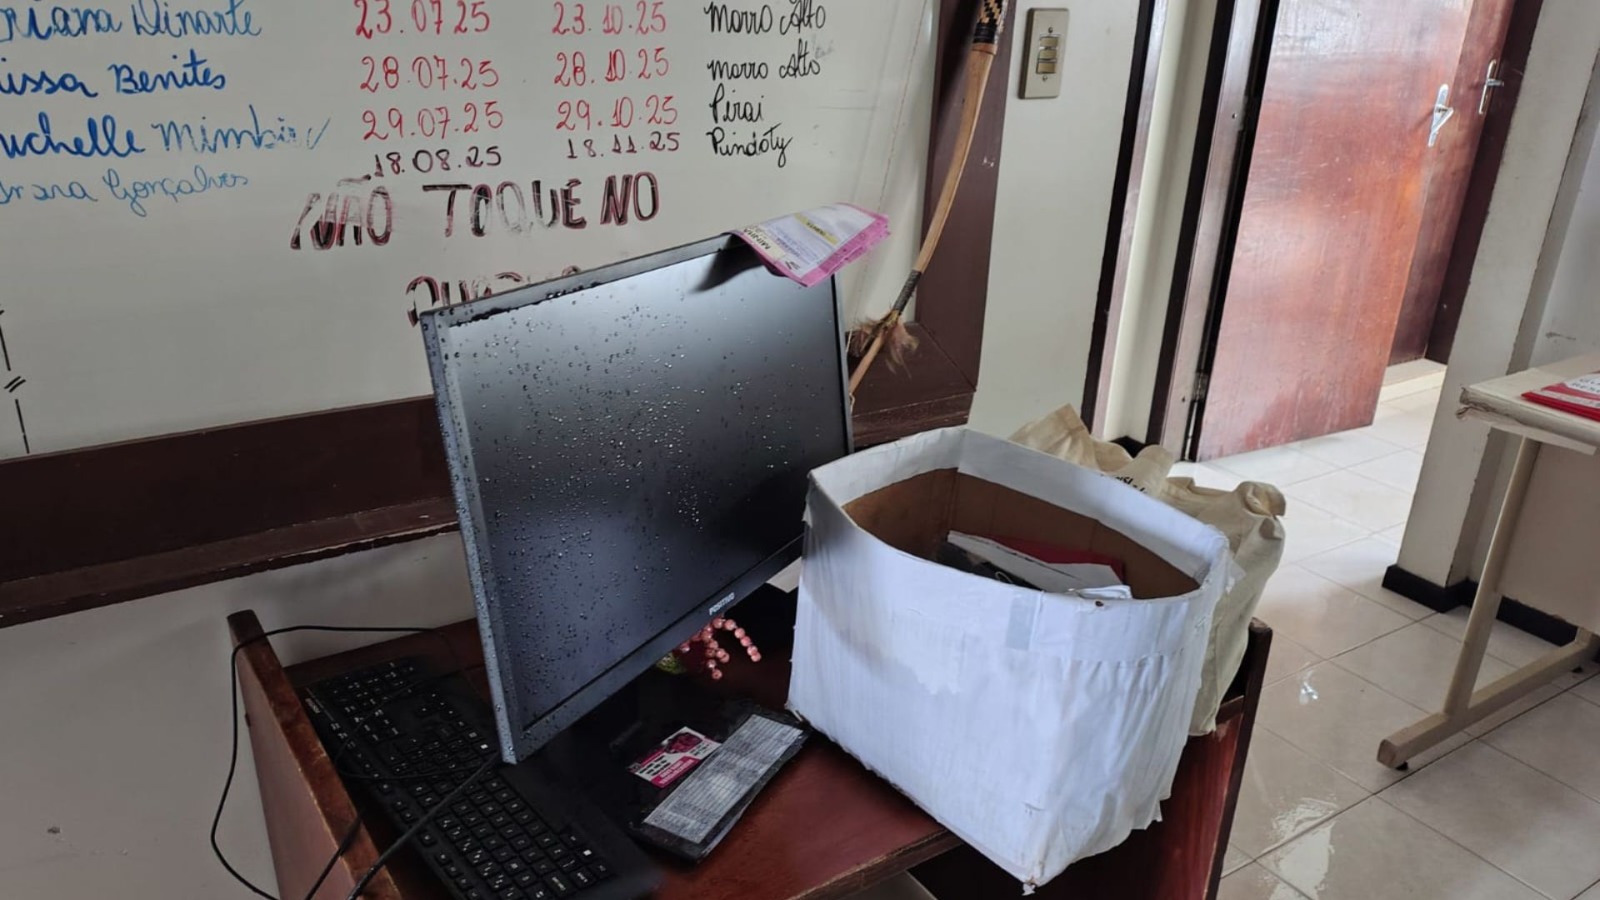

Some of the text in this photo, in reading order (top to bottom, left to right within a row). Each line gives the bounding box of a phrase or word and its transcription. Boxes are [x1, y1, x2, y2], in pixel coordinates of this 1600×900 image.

[551, 0, 667, 36] 23.10.25
[108, 48, 227, 95] Benites
[360, 55, 501, 93] 28.07.25
[553, 46, 670, 87] 28.10.25
[362, 101, 504, 141] 29.07.25
[555, 94, 679, 131] 29.10.25
[374, 144, 503, 178] 18.08.25
[566, 130, 681, 159] 18.11.25
[422, 178, 589, 238] TOQUE
[600, 171, 660, 226] NO
